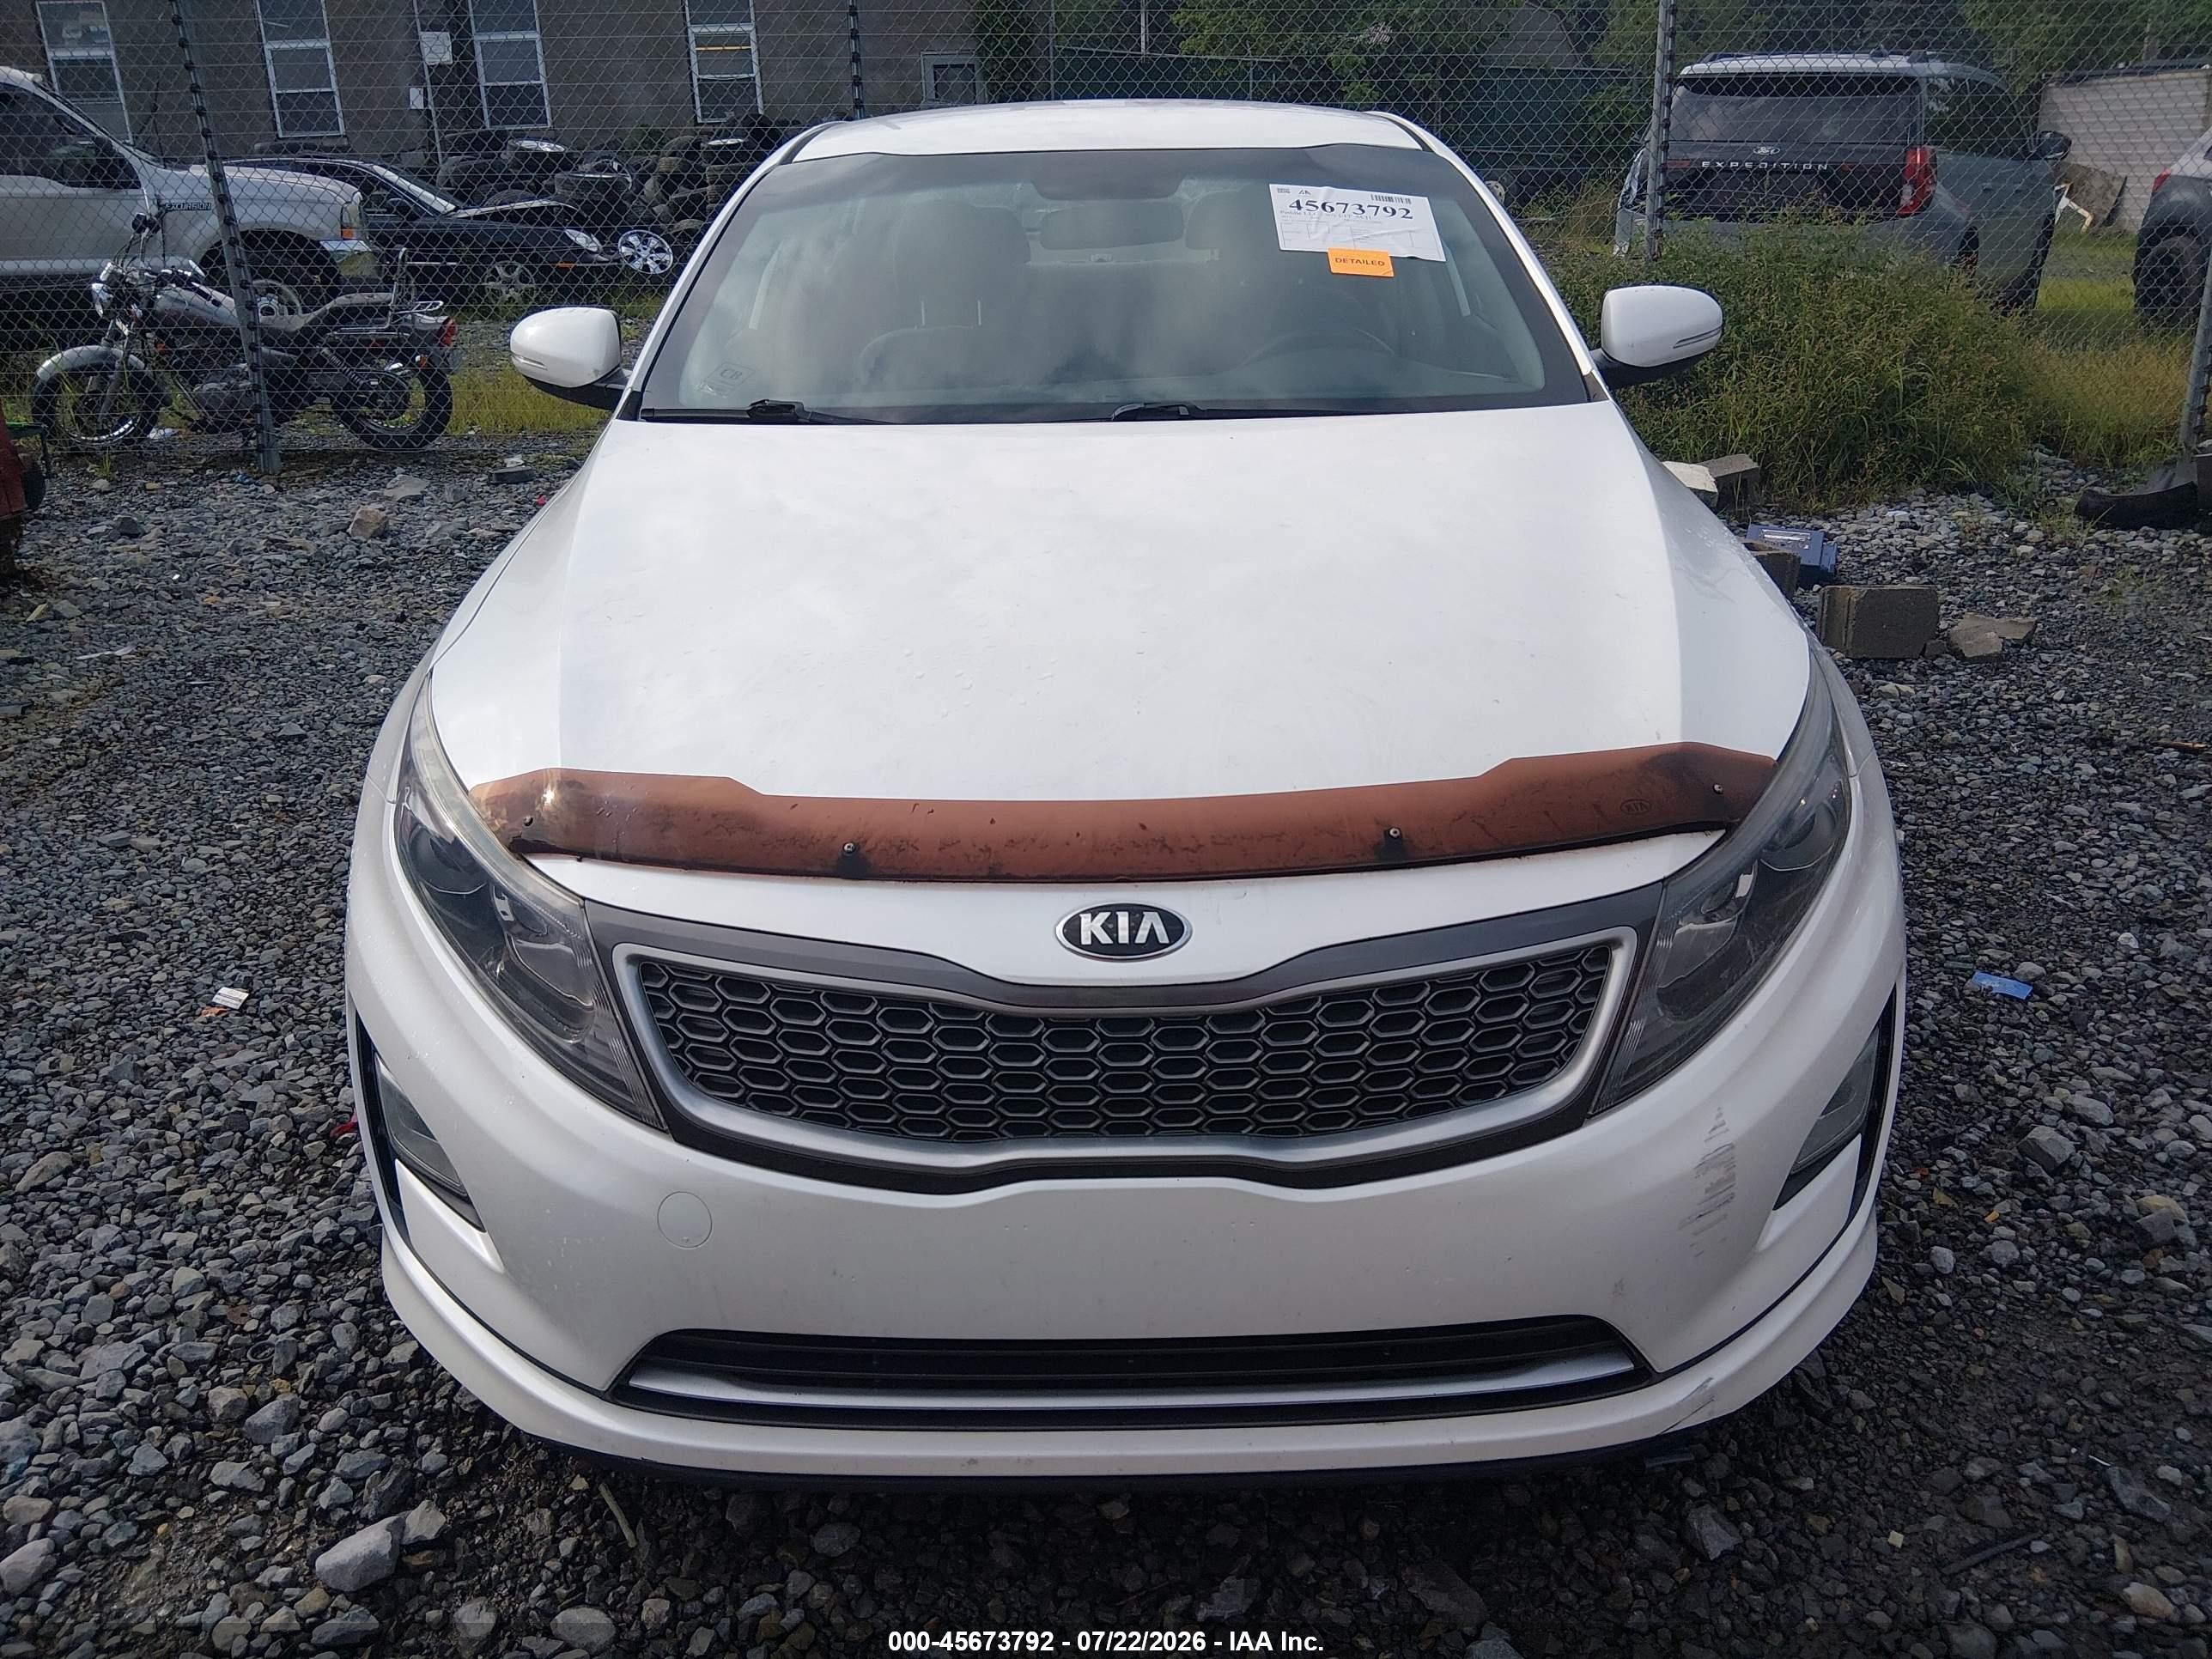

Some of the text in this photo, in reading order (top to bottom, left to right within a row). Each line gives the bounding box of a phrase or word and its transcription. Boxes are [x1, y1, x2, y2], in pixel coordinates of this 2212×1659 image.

[1701, 161, 1828, 170] EXPEDITION
[165, 202, 211, 211] EXCURSION
[1288, 198, 1413, 220] 45673792
[1334, 257, 1385, 267] DETAILED
[1079, 911, 1170, 945] KIA
